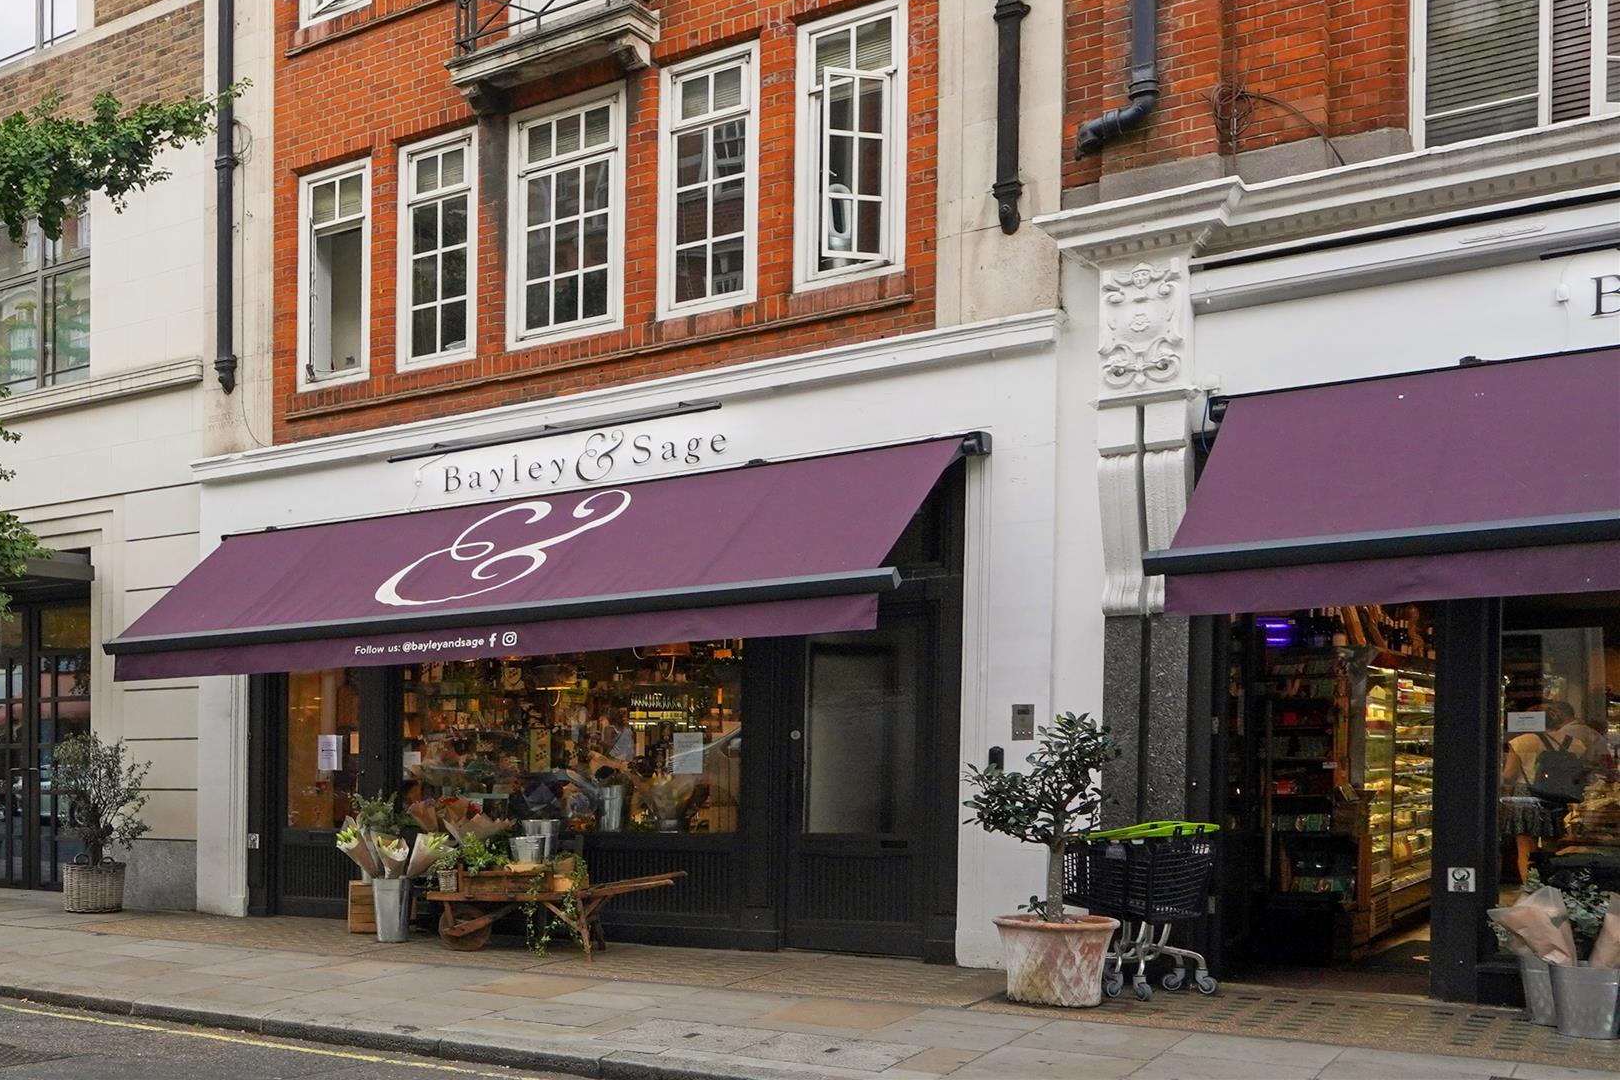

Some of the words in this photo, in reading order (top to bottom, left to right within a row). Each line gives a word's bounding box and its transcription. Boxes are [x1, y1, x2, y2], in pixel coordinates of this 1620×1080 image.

[443, 454, 565, 494] Bayley
[575, 429, 626, 482] &
[632, 432, 727, 465] Sage
[354, 645, 384, 655] Follow
[388, 644, 401, 653] us:
[402, 636, 485, 653] @bayleyandsage
